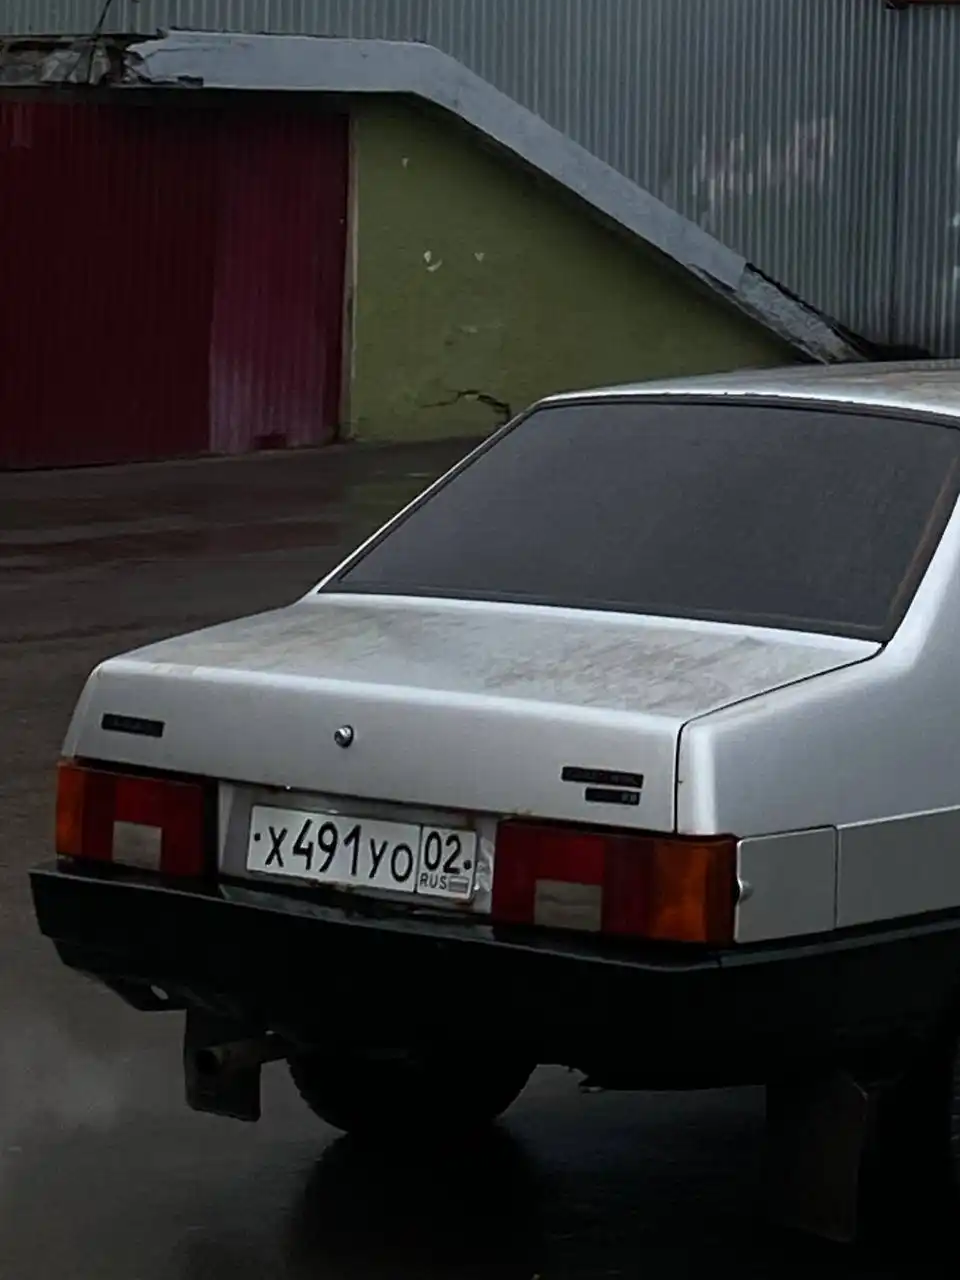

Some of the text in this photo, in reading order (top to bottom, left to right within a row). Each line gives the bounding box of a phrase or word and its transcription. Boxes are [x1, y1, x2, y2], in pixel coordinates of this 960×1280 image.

[265, 818, 461, 882] Х491УО 02
[419, 872, 448, 890] RUS
